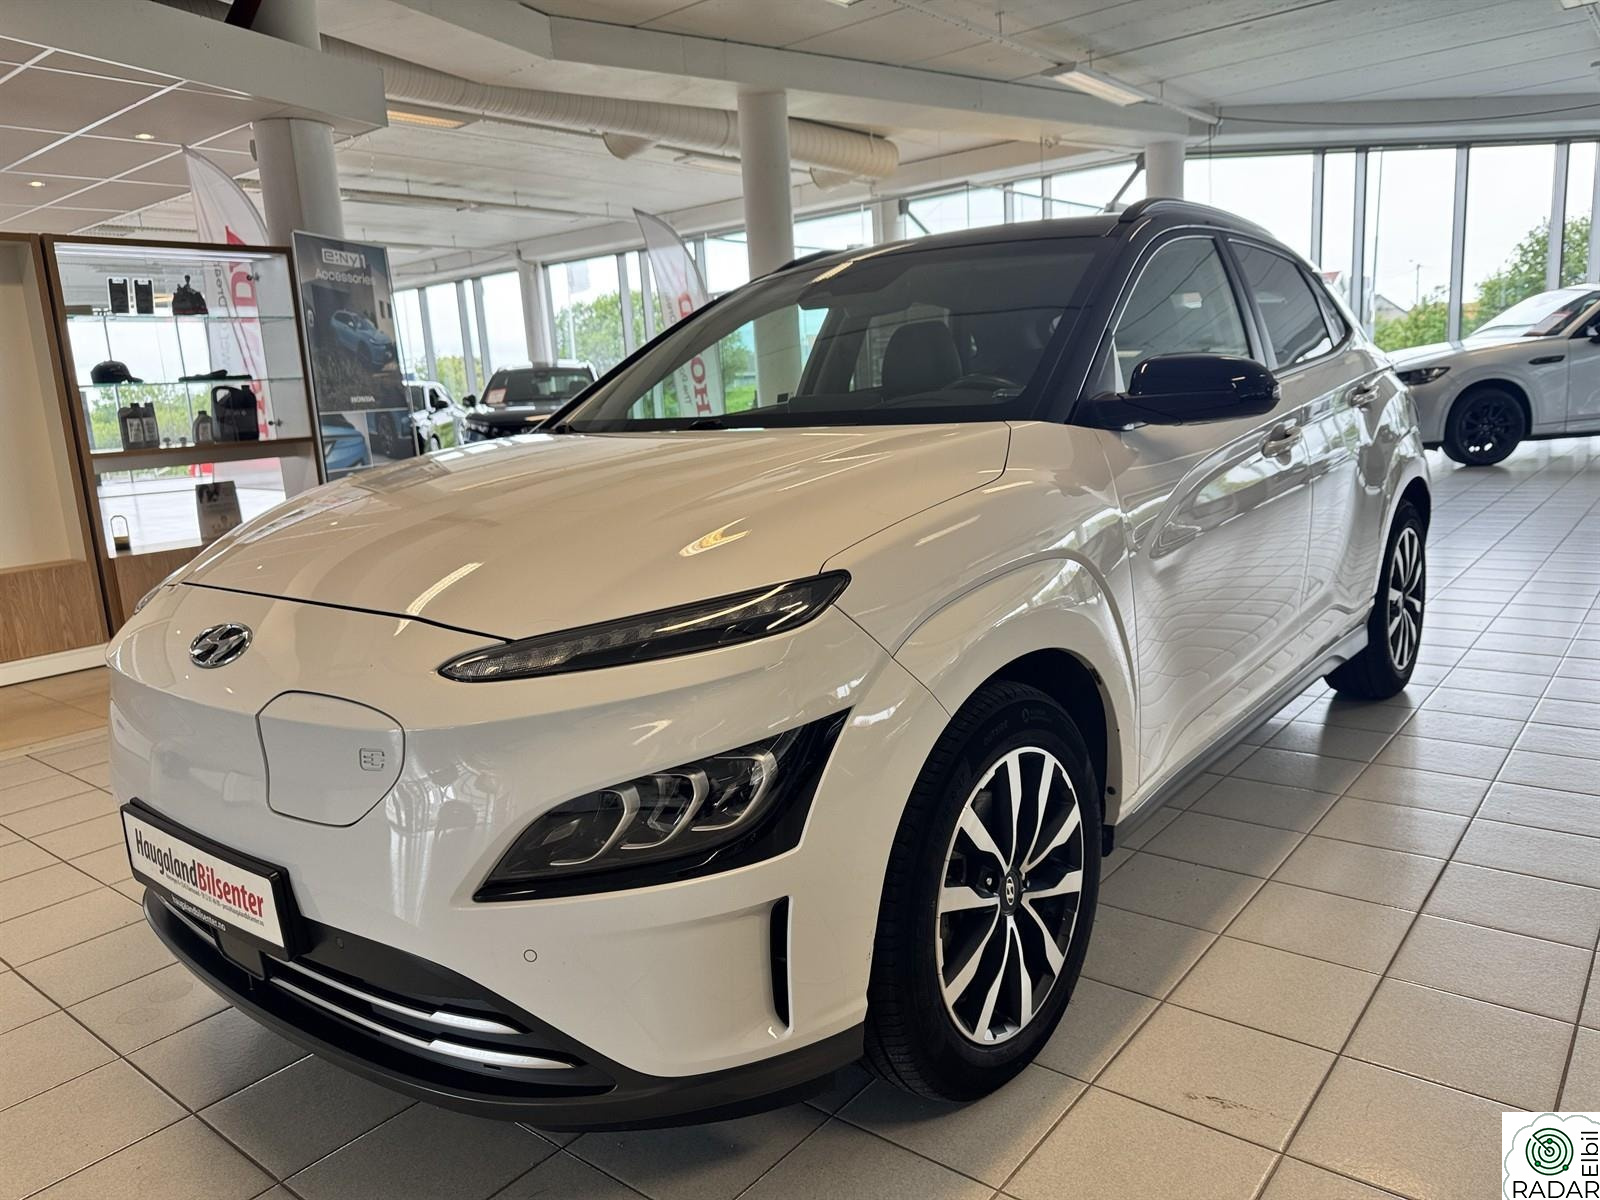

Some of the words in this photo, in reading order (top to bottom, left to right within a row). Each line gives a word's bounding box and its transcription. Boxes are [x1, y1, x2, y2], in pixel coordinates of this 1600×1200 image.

[315, 268, 377, 287] Accessories
[351, 395, 376, 404] HONDA
[135, 828, 264, 918] HaugalandBilsenter
